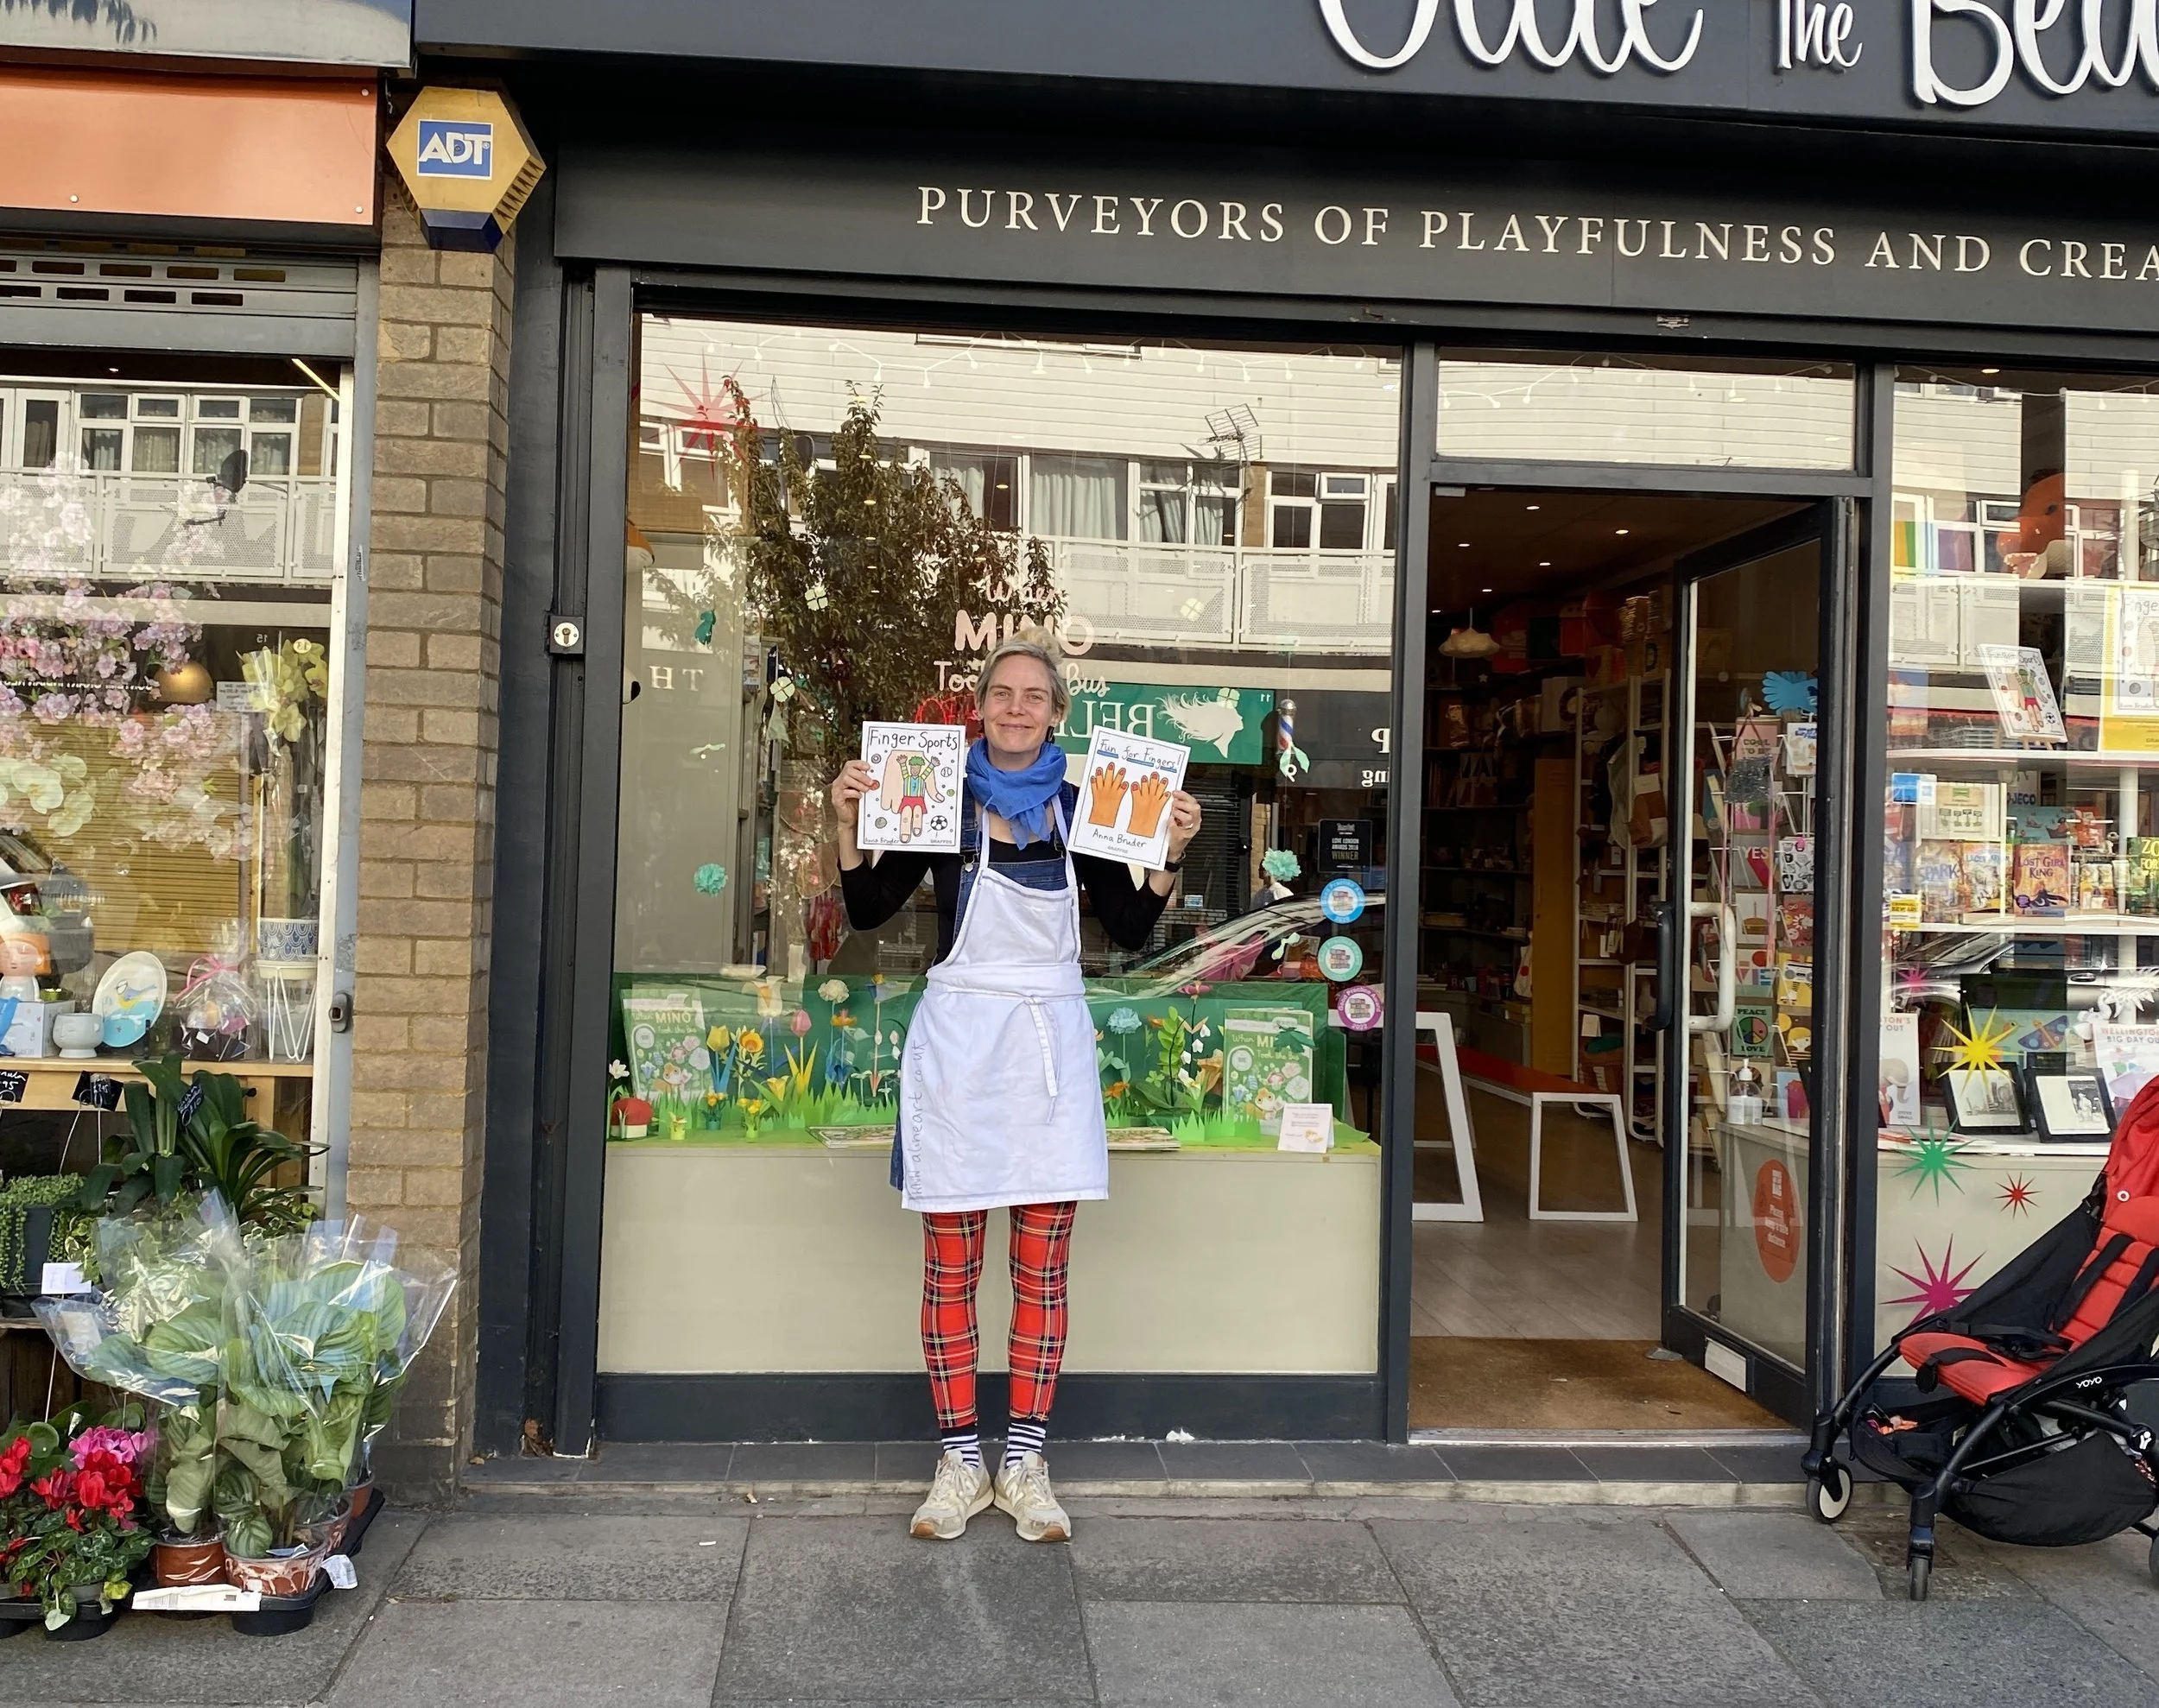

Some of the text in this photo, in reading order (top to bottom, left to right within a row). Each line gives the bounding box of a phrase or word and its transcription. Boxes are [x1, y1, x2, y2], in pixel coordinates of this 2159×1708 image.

[418, 131, 492, 165] ADT
[916, 186, 1284, 243] PURVEYORS
[1314, 206, 1389, 246] OF
[1420, 210, 1836, 266] PLAYFULNESS
[1865, 231, 1991, 273] AND
[934, 661, 1111, 698] Too Bus
[870, 729, 959, 754] Finger Sports
[1100, 738, 1117, 754] Fun
[1121, 745, 1140, 760] for
[1092, 828, 1147, 848] Anna Bruder
[1331, 851, 1358, 861] WINNER
[2075, 1376, 2103, 1389] YOYO
